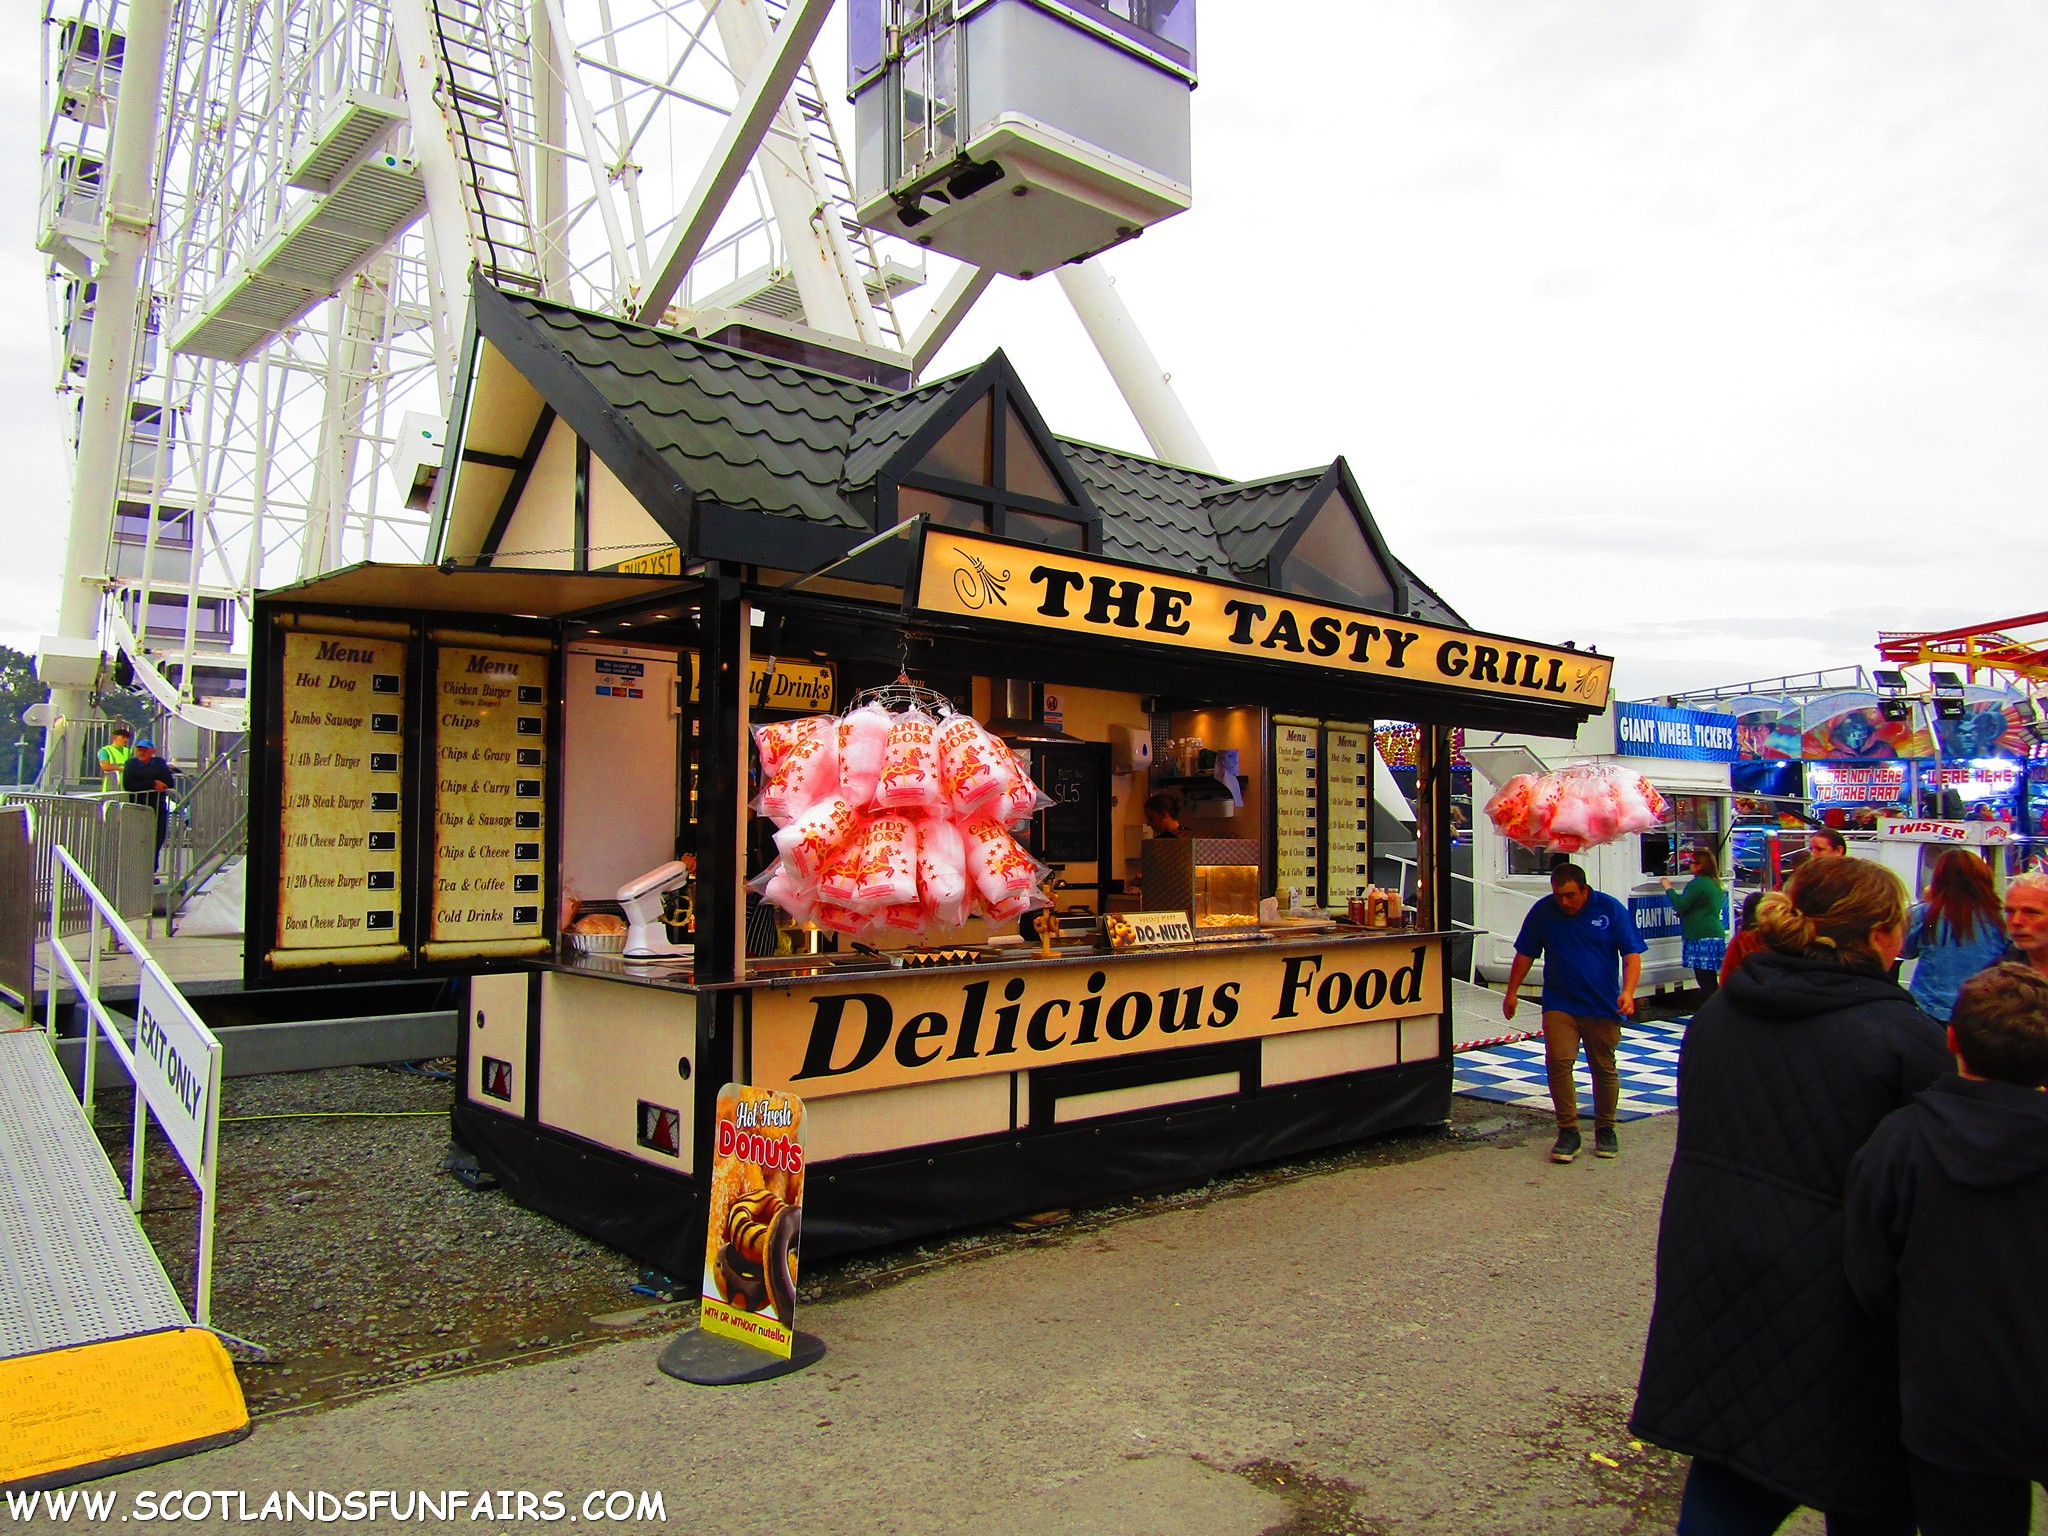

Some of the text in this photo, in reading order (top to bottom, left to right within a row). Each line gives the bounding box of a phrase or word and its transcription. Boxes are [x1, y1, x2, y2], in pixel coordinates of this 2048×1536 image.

[650, 552, 673, 574] YST
[1029, 564, 1569, 694] THE TASTY GRILL
[314, 640, 376, 664] Menu
[465, 655, 520, 676] Menu
[295, 673, 321, 688] Hot
[328, 674, 357, 692] Dog
[443, 681, 478, 696] Chicken
[482, 684, 512, 699] Burger
[773, 672, 830, 701] Drinks
[290, 710, 322, 726] Jumbo
[324, 712, 364, 730] Sausage
[442, 713, 480, 730] Chips
[886, 732, 932, 748] FLOSS
[938, 720, 976, 746] ANDY
[1286, 729, 1307, 743] Menu
[1337, 735, 1357, 748] Menu
[1620, 716, 1733, 751] GIANT WHEEL TICKETS
[289, 752, 312, 768] 1/4lb
[313, 752, 332, 766] Beef
[334, 753, 361, 770] Burger
[441, 746, 468, 762] Chips
[472, 748, 480, 761] &
[484, 748, 512, 764] Gravy
[1850, 768, 1871, 784] NOT
[1873, 768, 1903, 784] HERE
[1975, 768, 2012, 784] HERE
[440, 779, 468, 795] Chips
[471, 780, 480, 793] &
[483, 780, 511, 795] Curry
[1054, 783, 1081, 804] SL5
[1817, 786, 1901, 802] TO TAKE PART
[288, 794, 310, 808] 1/2lb
[312, 794, 336, 808] Steak
[337, 794, 364, 810] Burger
[440, 812, 464, 828] Chips
[467, 812, 475, 826] &
[478, 812, 514, 828] Sausage
[968, 818, 1001, 836] CAN
[1888, 822, 1967, 840] TWISTER
[286, 833, 308, 848] 1/4lb
[310, 833, 336, 848] Cheese
[338, 834, 364, 849] Burger
[439, 845, 465, 861] Chips
[468, 846, 476, 858] &
[480, 845, 510, 858] Cheese
[286, 874, 308, 889] 1/2lb
[308, 874, 335, 888] Cheese
[337, 874, 363, 889] Burger
[438, 878, 456, 892] Tea
[461, 878, 471, 892] &
[474, 878, 506, 891] Coffee
[285, 916, 308, 930] Bacon
[310, 915, 335, 930] Cheese
[336, 914, 361, 930] Burger
[437, 910, 462, 924] Cold
[466, 908, 504, 923] Drinks
[1635, 907, 1662, 929] GIANT
[1136, 924, 1190, 943] DO-NUTS
[788, 945, 1426, 1083] Delicious Food
[140, 1005, 202, 1121] EXIT ONLY
[736, 1099, 792, 1128] Hot Fresh
[718, 1118, 803, 1174] Donuts
[704, 1305, 718, 1318] WITH
[720, 1310, 729, 1322] OR
[730, 1314, 757, 1335] WITHOUT
[758, 1325, 785, 1344] nutella
